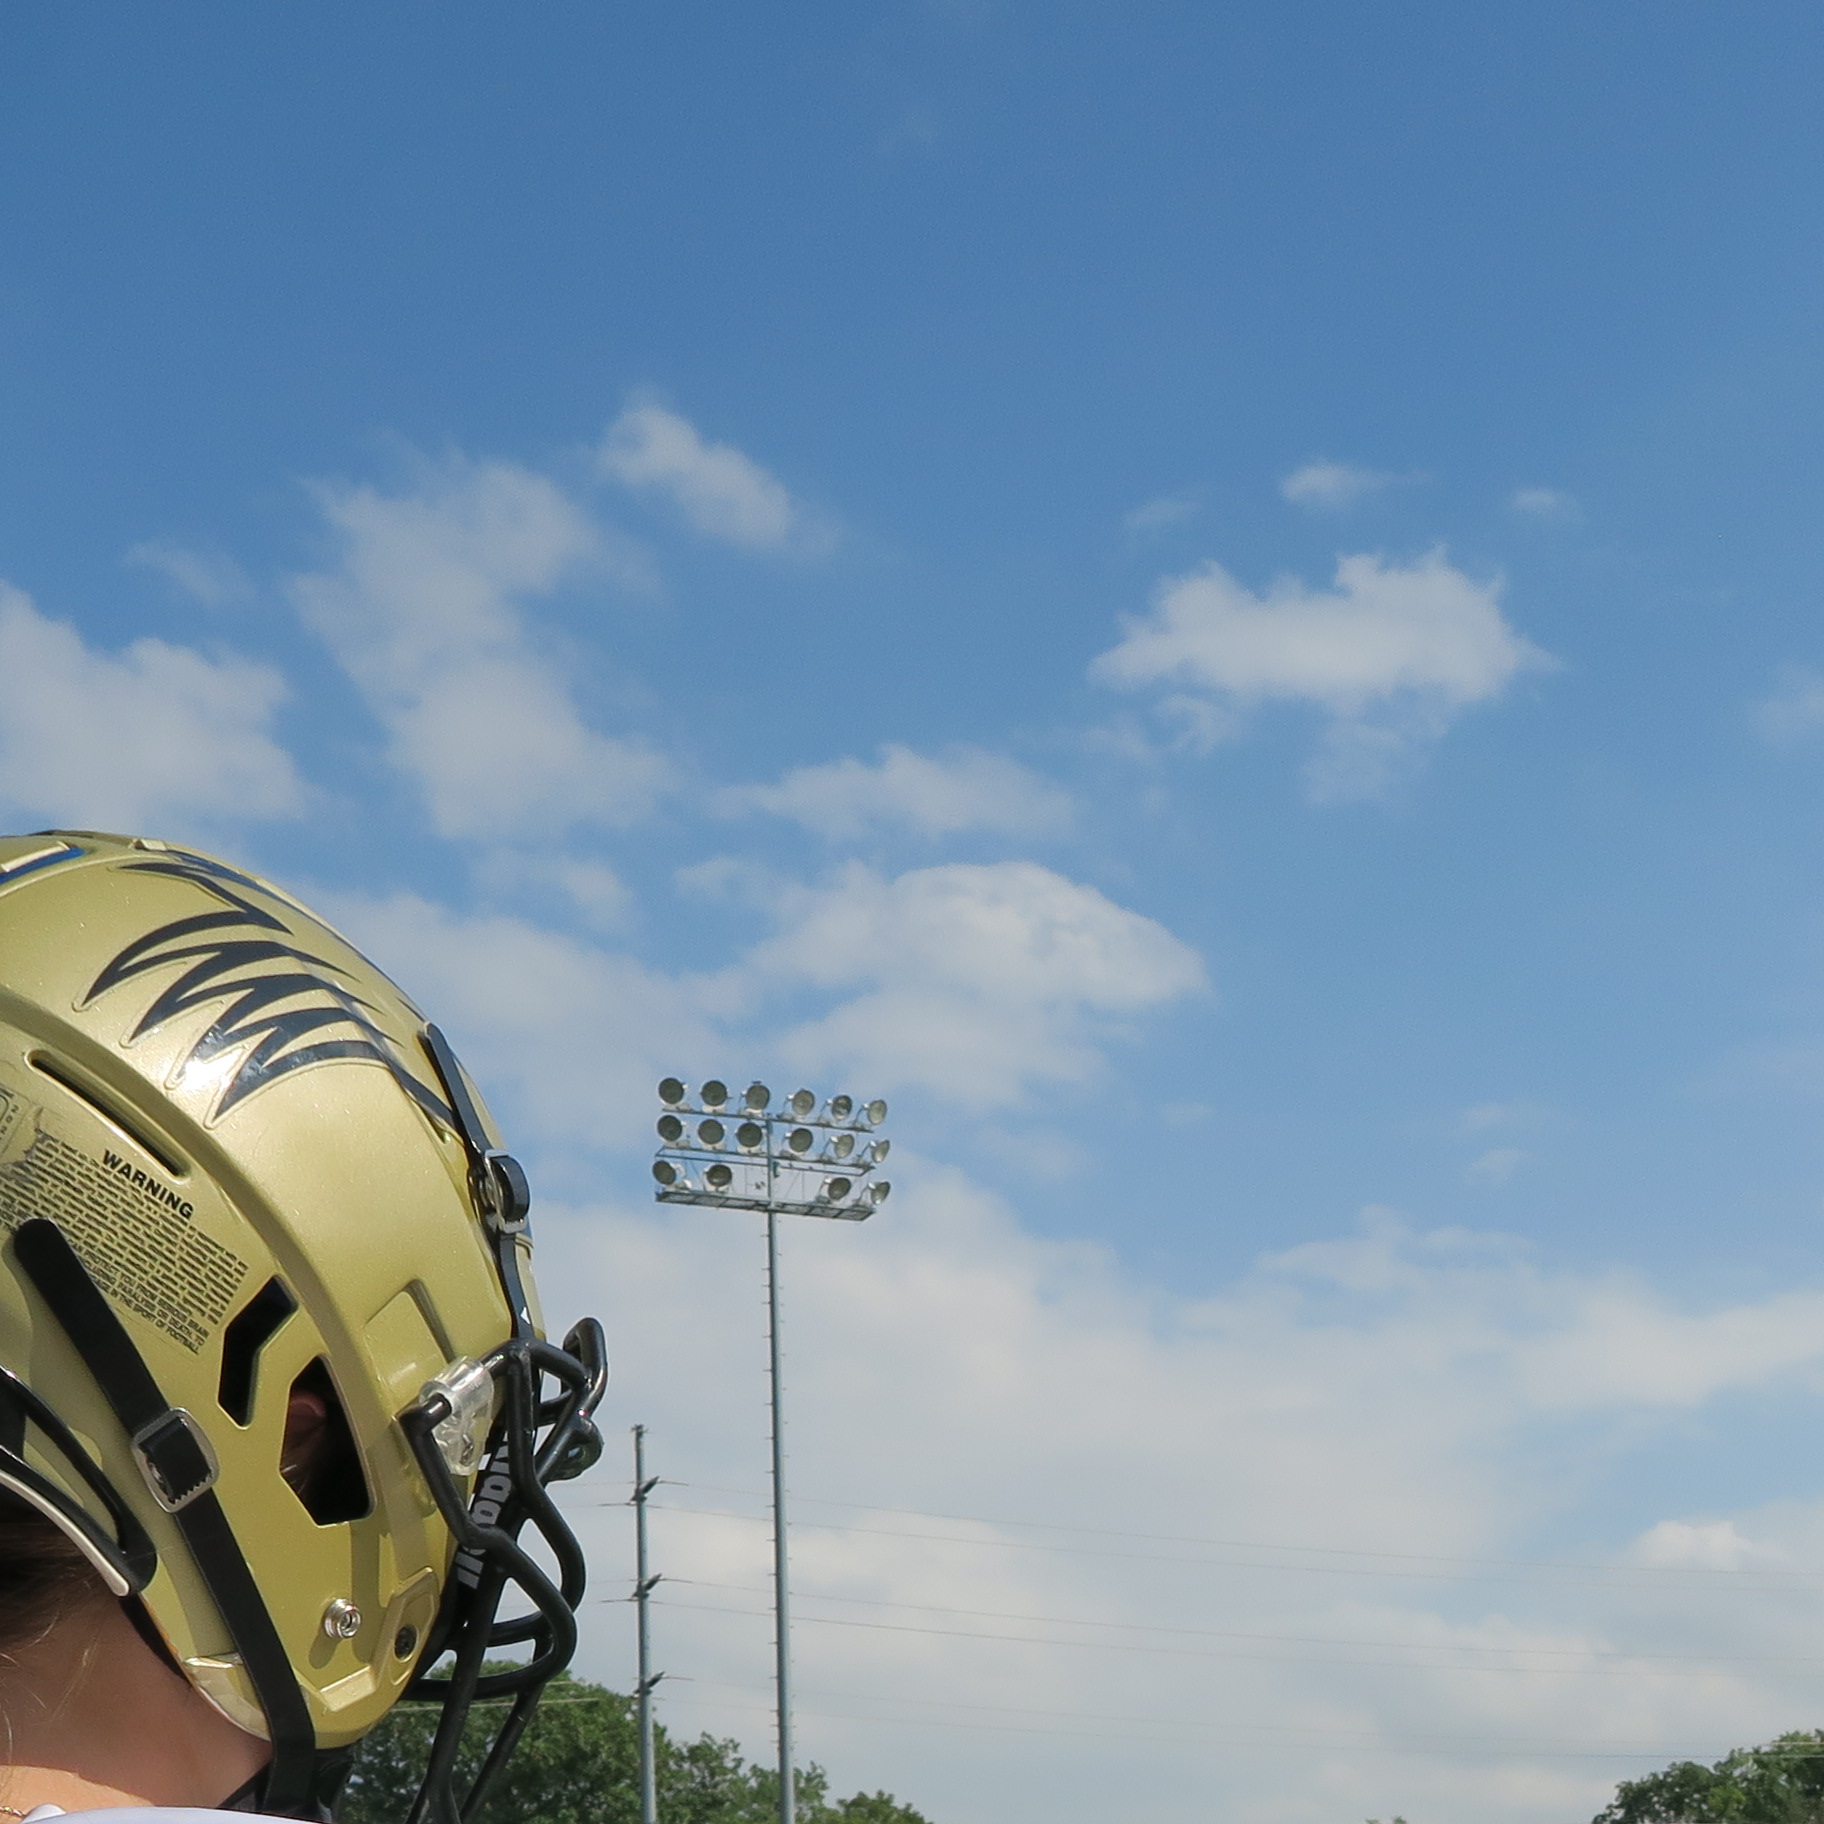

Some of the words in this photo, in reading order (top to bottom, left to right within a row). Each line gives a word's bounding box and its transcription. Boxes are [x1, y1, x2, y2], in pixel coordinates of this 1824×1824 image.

[102, 1150, 194, 1219] WARNING
[83, 1249, 119, 1276] PROTECT
[134, 1283, 157, 1302] FROM
